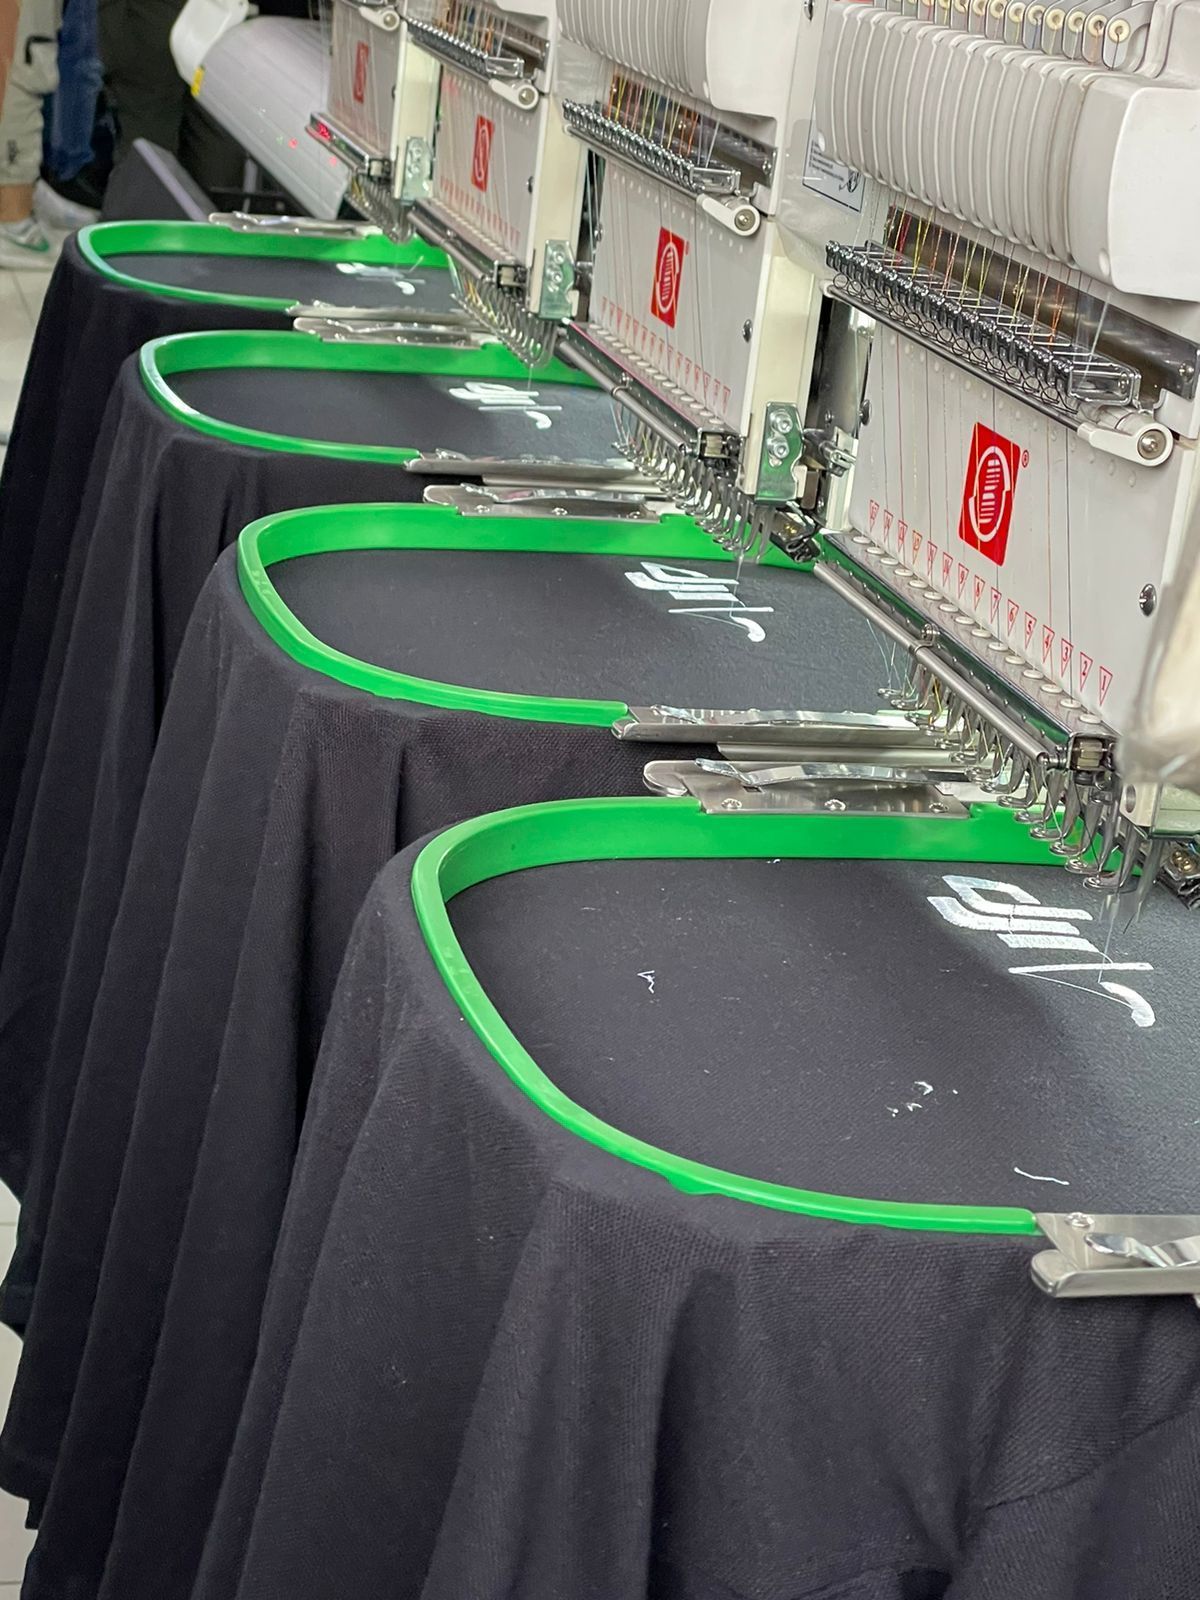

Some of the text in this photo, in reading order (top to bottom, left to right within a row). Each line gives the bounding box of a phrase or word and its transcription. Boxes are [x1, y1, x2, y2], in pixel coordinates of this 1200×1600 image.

[960, 571, 965, 584] 9
[976, 582, 980, 597] 8
[993, 594, 999, 609] 7
[1009, 607, 1015, 622] 6
[1026, 620, 1032, 635] 5
[1045, 634, 1050, 648] 4
[1063, 647, 1068, 661] 3
[1082, 660, 1088, 676] 2
[1102, 675, 1107, 691] 1
